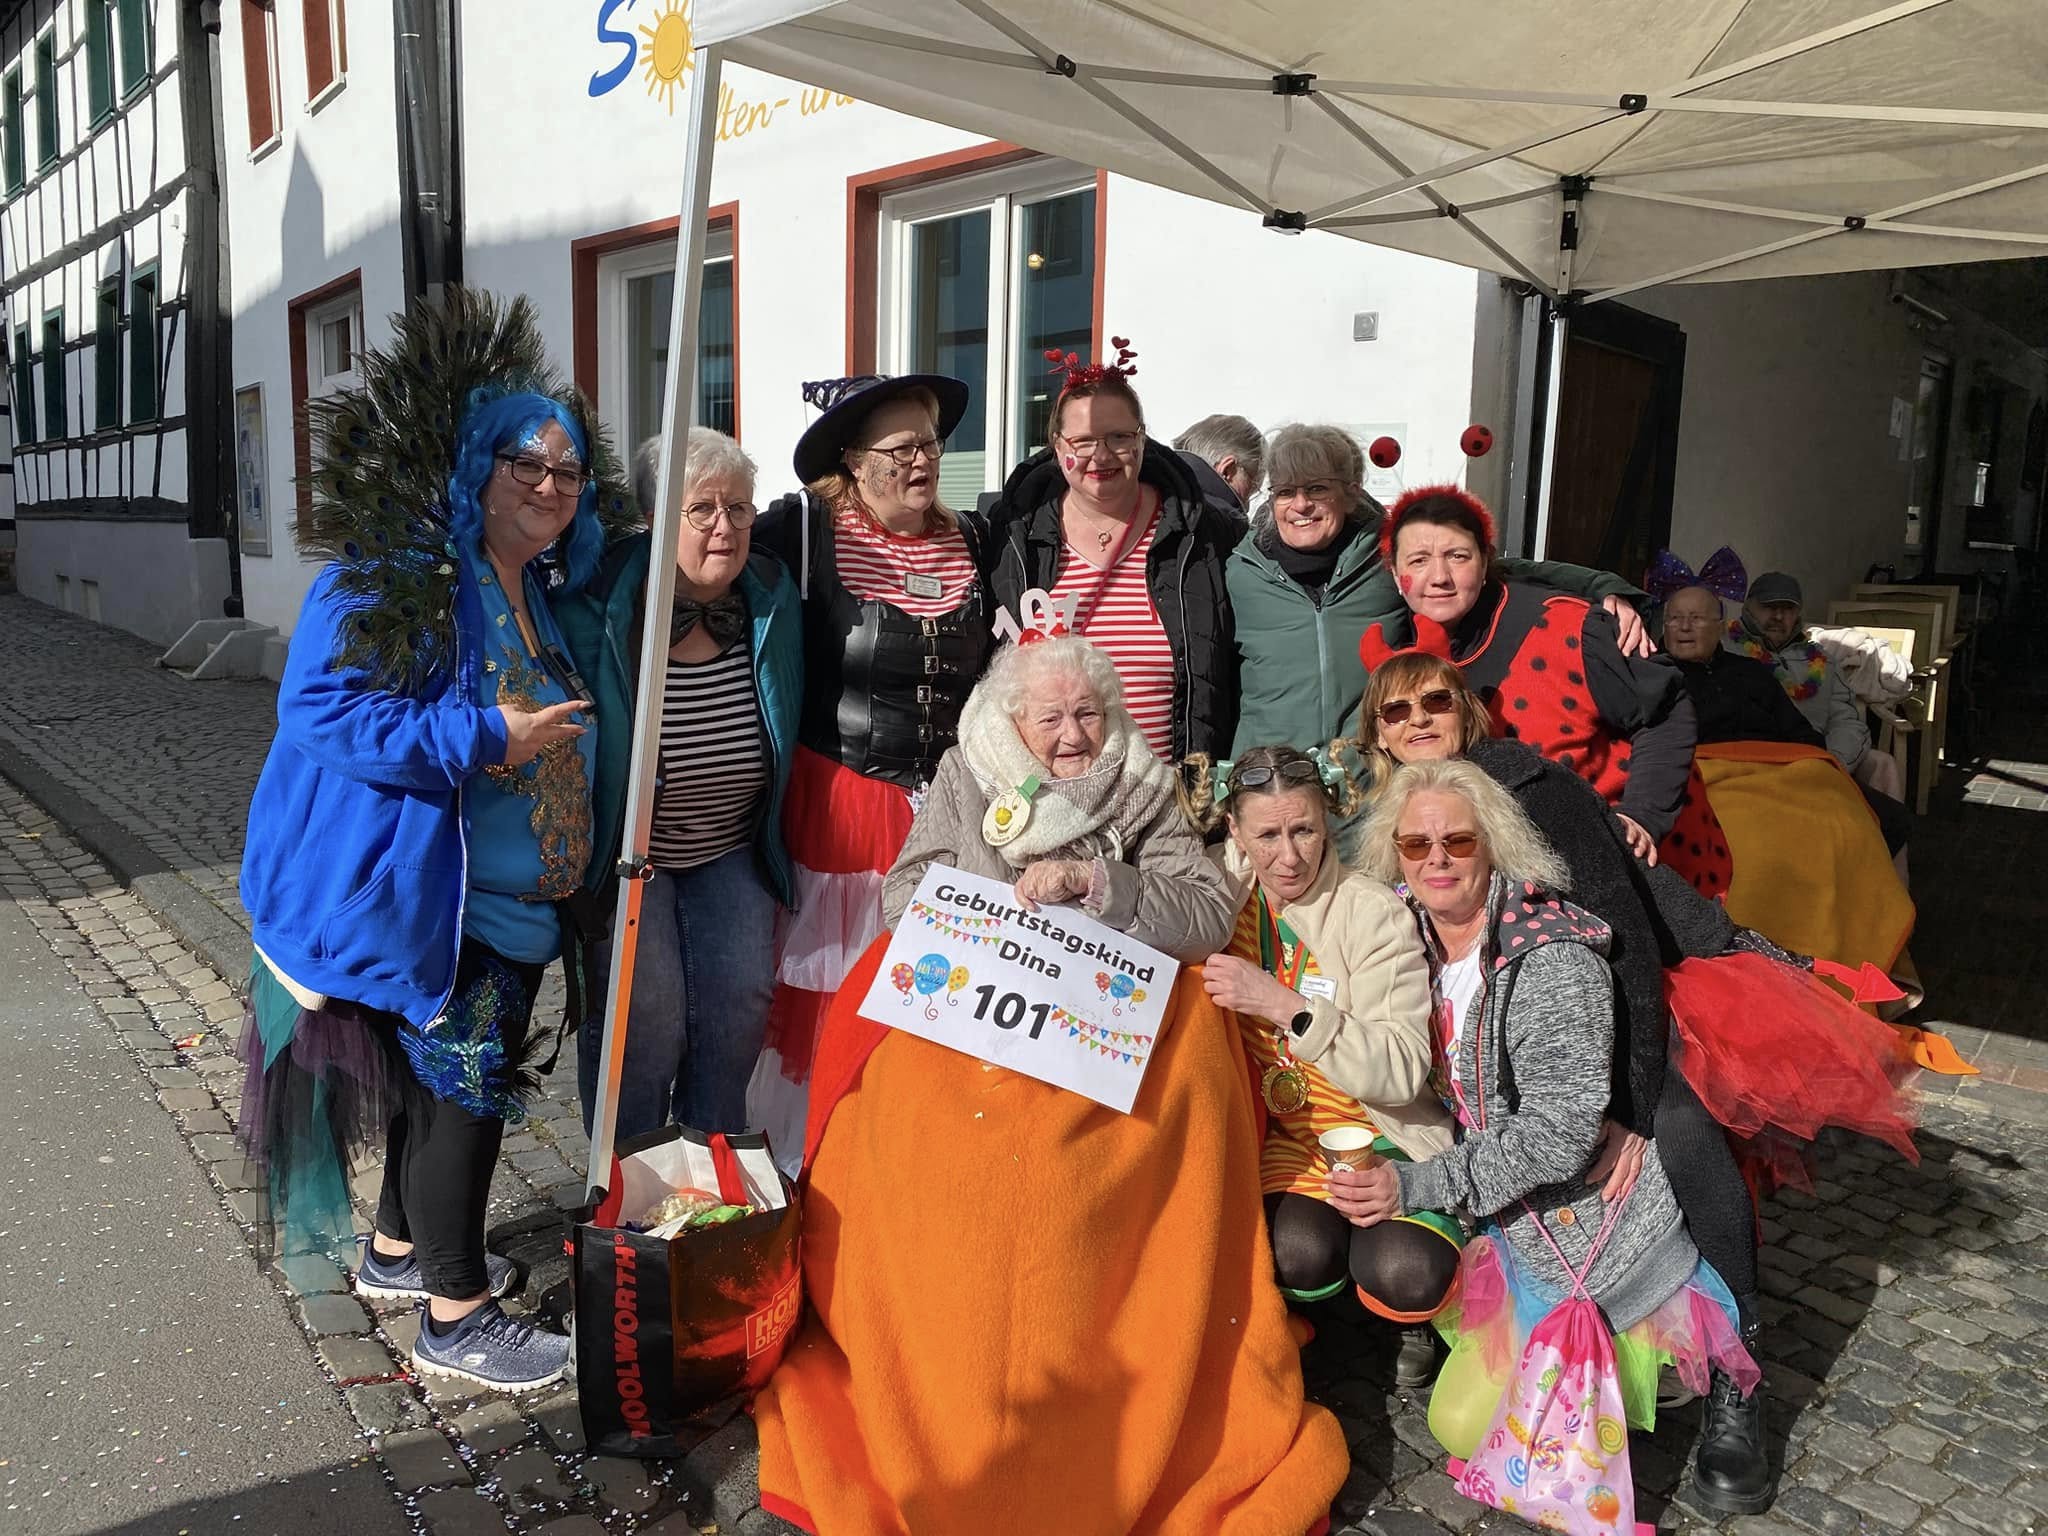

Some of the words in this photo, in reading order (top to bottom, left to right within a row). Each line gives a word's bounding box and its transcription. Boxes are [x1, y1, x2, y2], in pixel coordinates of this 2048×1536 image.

[935, 884, 1155, 984] Geburtstagskind
[999, 940, 1062, 980] Dina
[973, 984, 1052, 1040] 101
